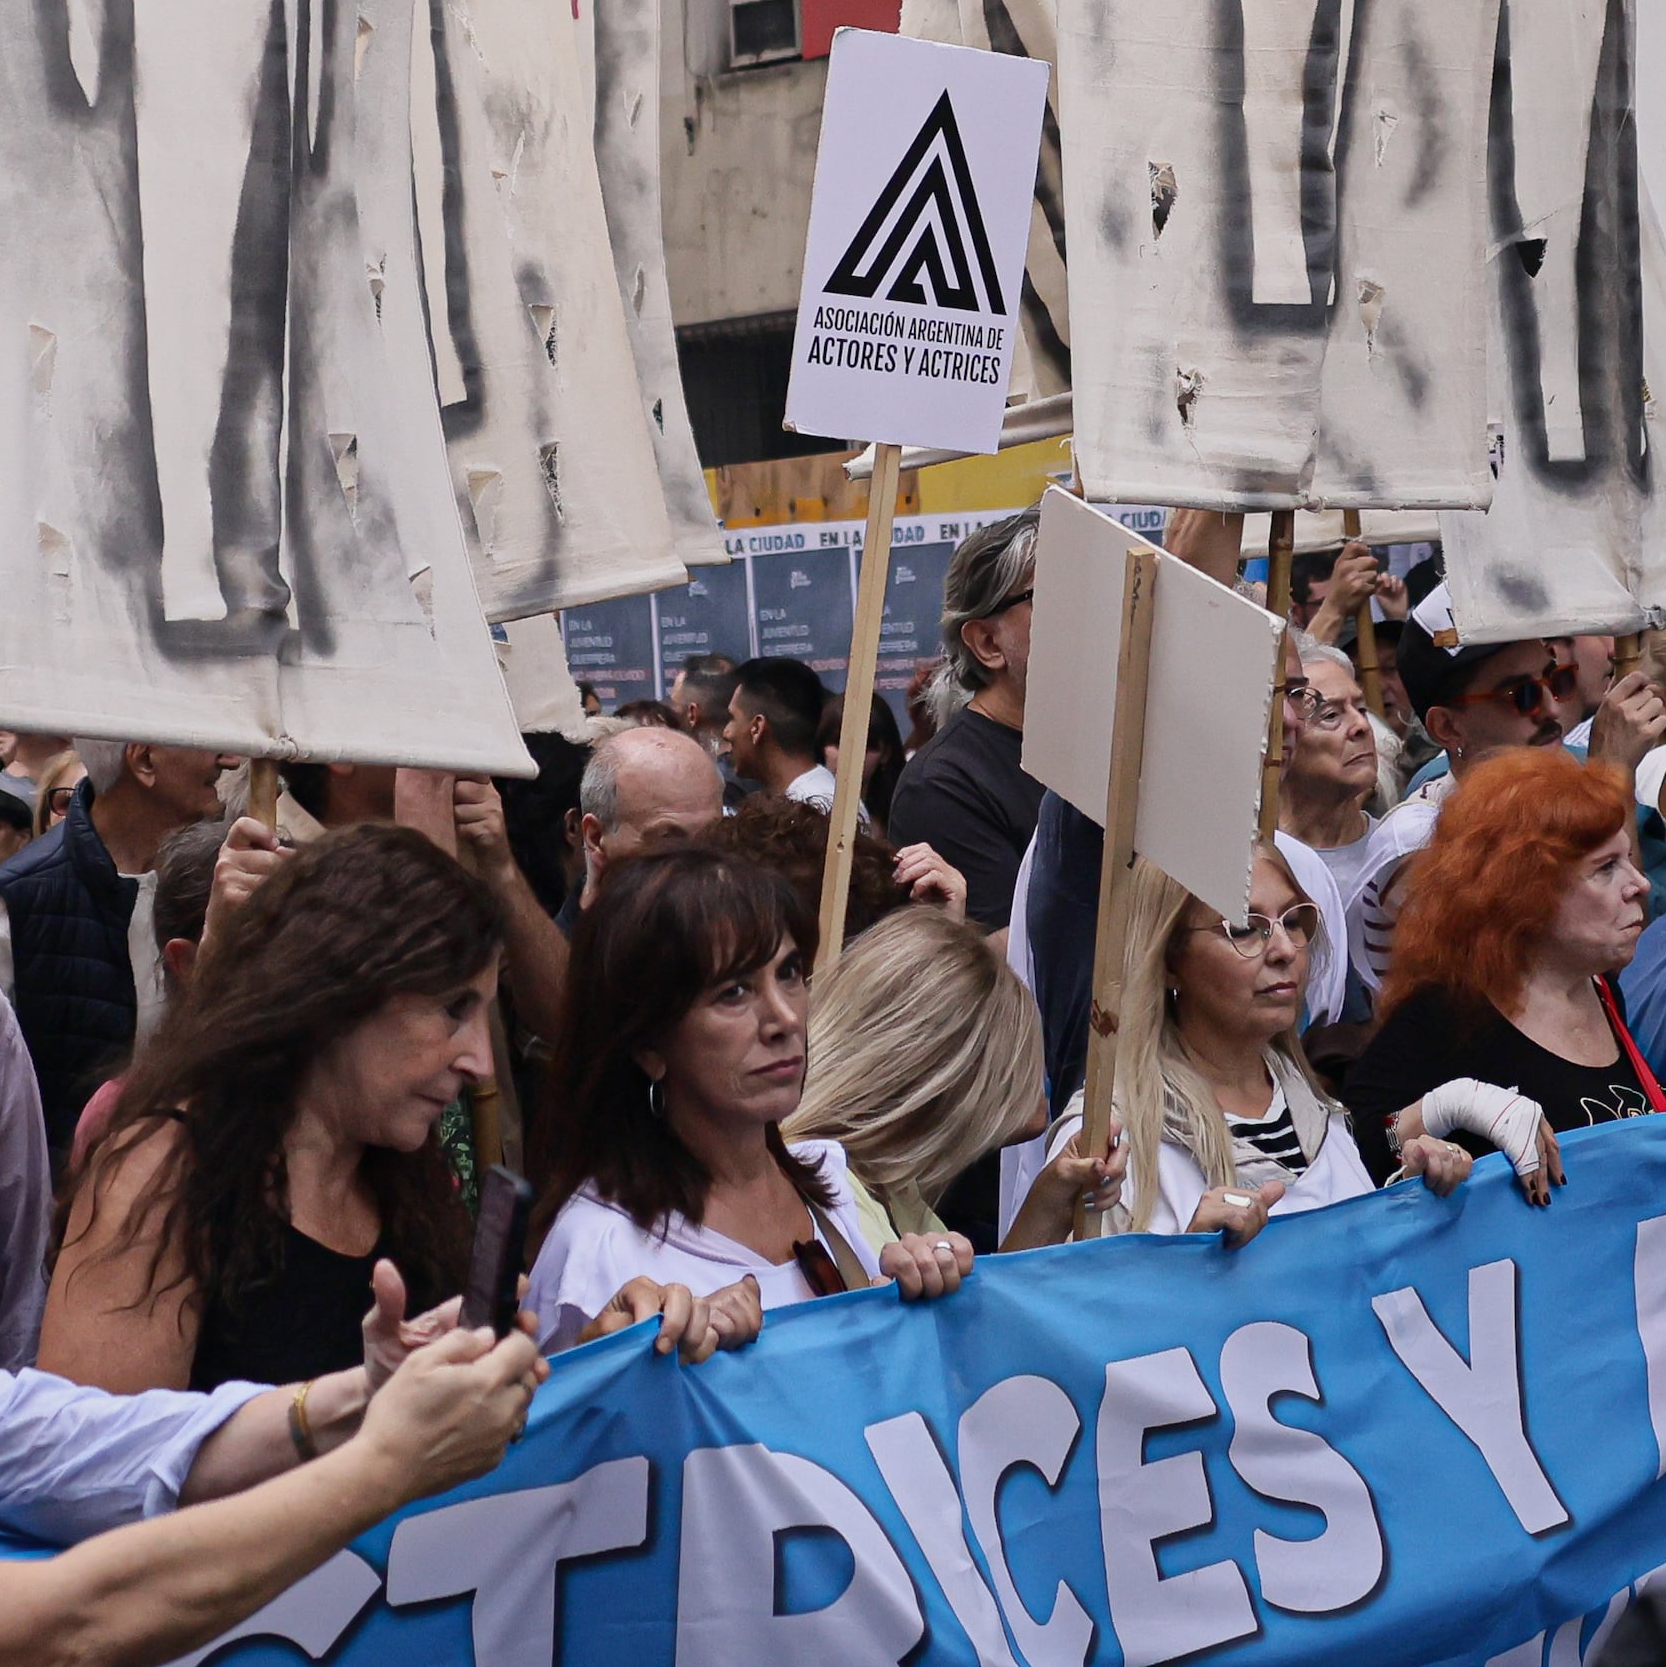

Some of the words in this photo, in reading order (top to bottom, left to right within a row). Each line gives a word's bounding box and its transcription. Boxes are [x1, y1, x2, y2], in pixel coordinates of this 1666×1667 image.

[813, 306, 905, 337] ASOCIACIÓN
[908, 317, 983, 349] ARGENTINA
[986, 327, 1004, 351] DE
[807, 335, 899, 373] ACTORES
[903, 346, 916, 375] Y
[917, 348, 1001, 384] ACTRICES
[749, 533, 805, 553] CIUDAD
[819, 531, 838, 548] EN
[844, 530, 862, 547] LA
[940, 523, 959, 539] EN
[1370, 1258, 1572, 1535] Y
